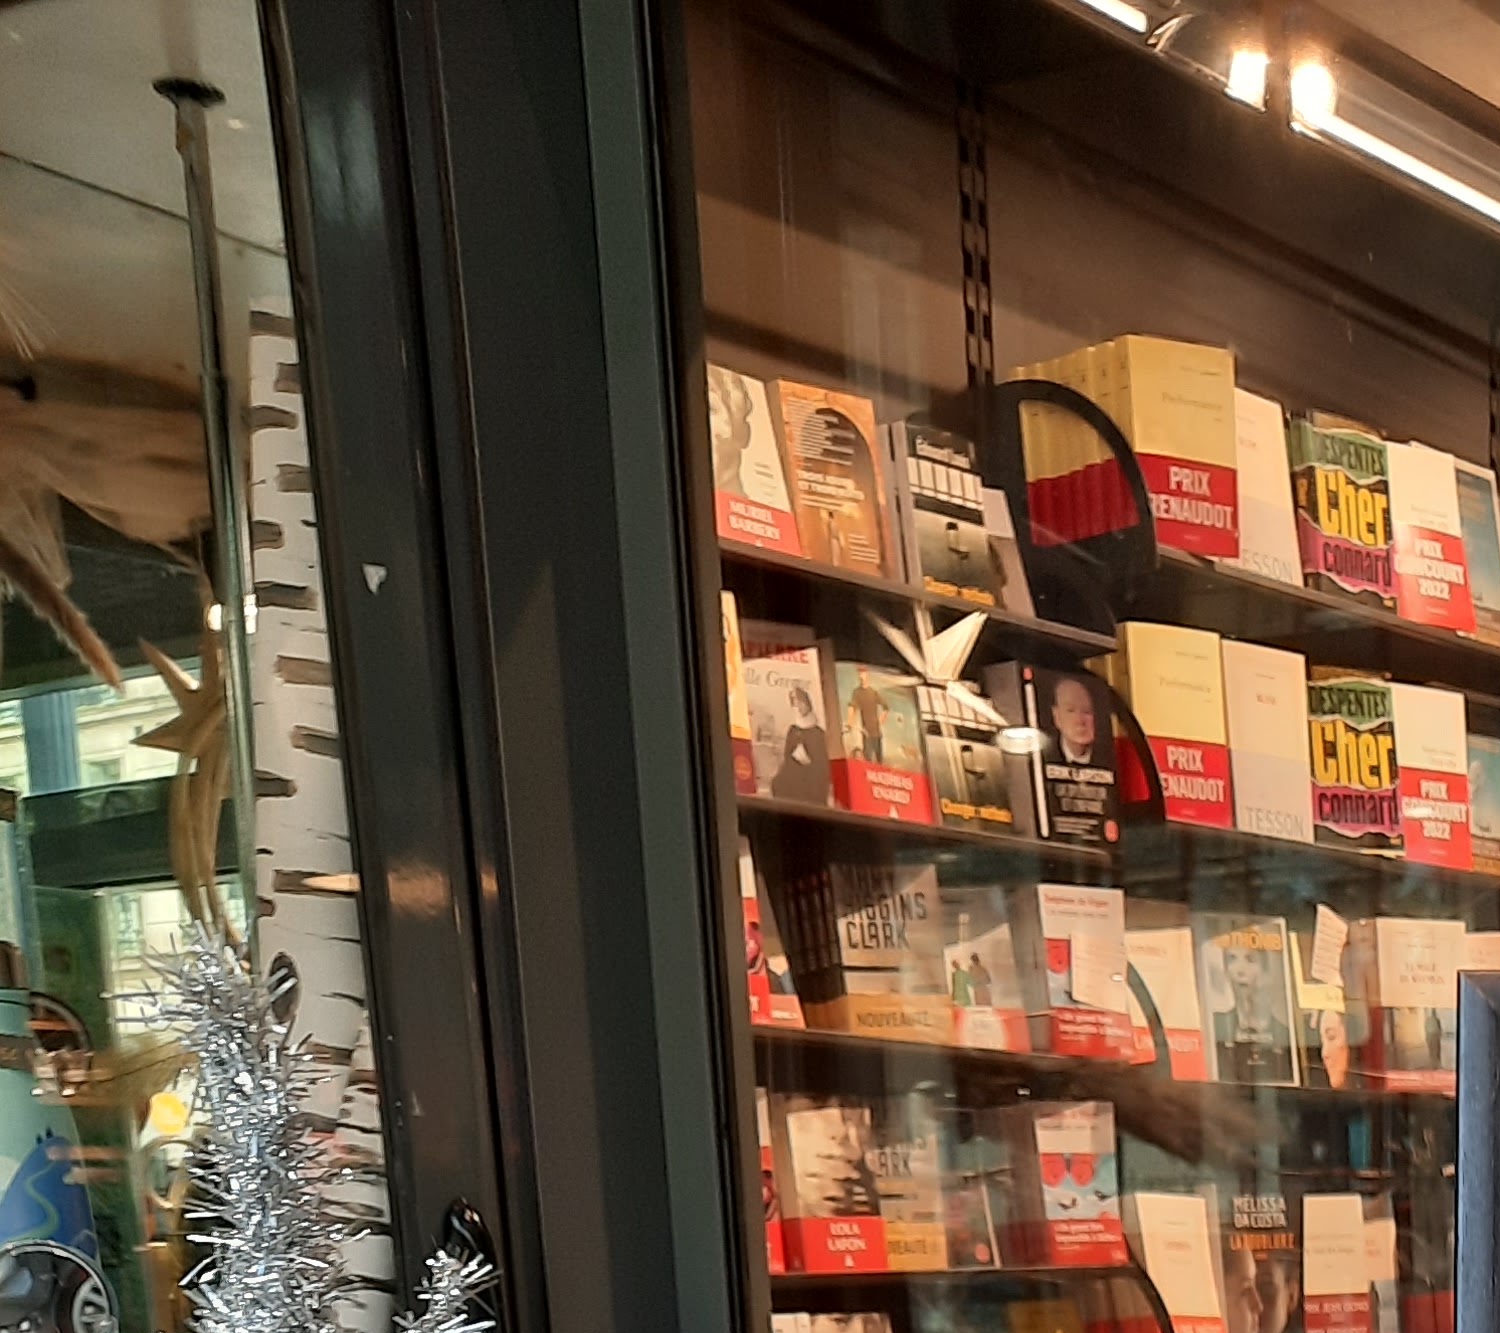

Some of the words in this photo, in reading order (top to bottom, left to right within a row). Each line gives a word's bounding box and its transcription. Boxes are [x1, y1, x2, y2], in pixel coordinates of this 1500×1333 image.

[1169, 465, 1211, 496] PRIX
[1316, 469, 1388, 548] Cher
[1324, 541, 1392, 587] connard
[1166, 745, 1204, 773] PRIX
[1312, 719, 1393, 789] Cher
[1160, 772, 1224, 802] ENAUDOT
[1319, 787, 1399, 825] connard
[846, 921, 910, 950] CLARK
[1234, 1213, 1249, 1228] DA
[1251, 1213, 1287, 1228] COSTA
